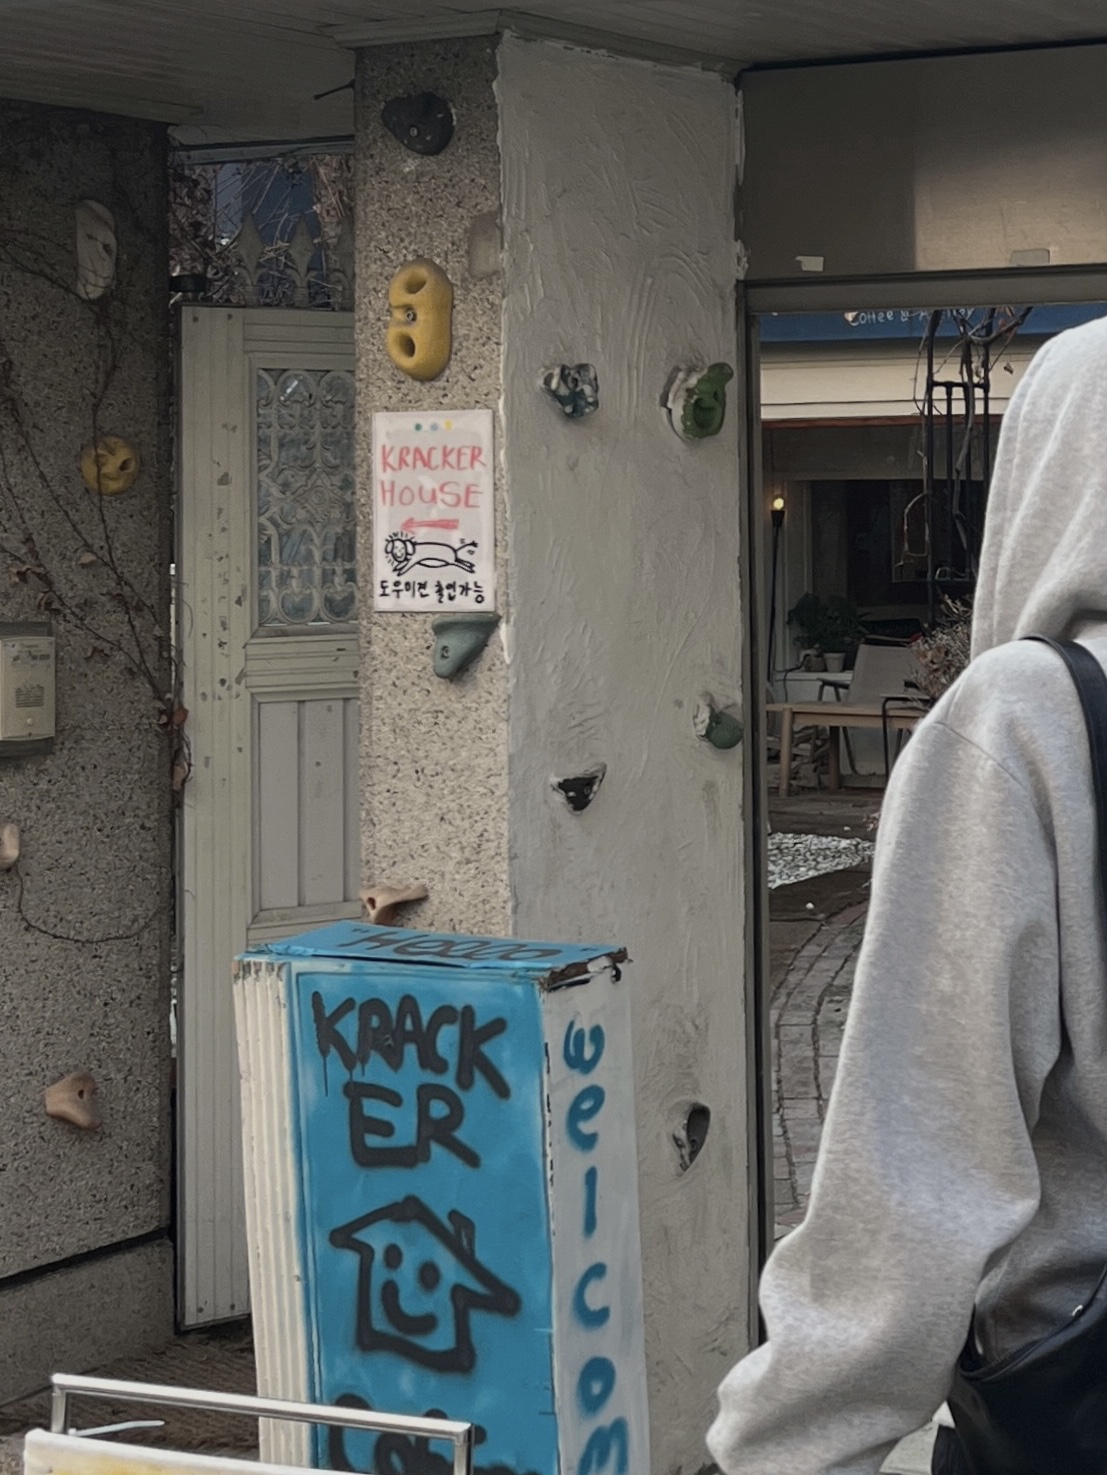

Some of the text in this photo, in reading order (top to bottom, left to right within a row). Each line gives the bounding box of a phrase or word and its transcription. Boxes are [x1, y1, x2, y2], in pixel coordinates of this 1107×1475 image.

[381, 444, 487, 473] KRACKER
[312, 990, 511, 1100] KRACK
[342, 1081, 481, 1169] ER
